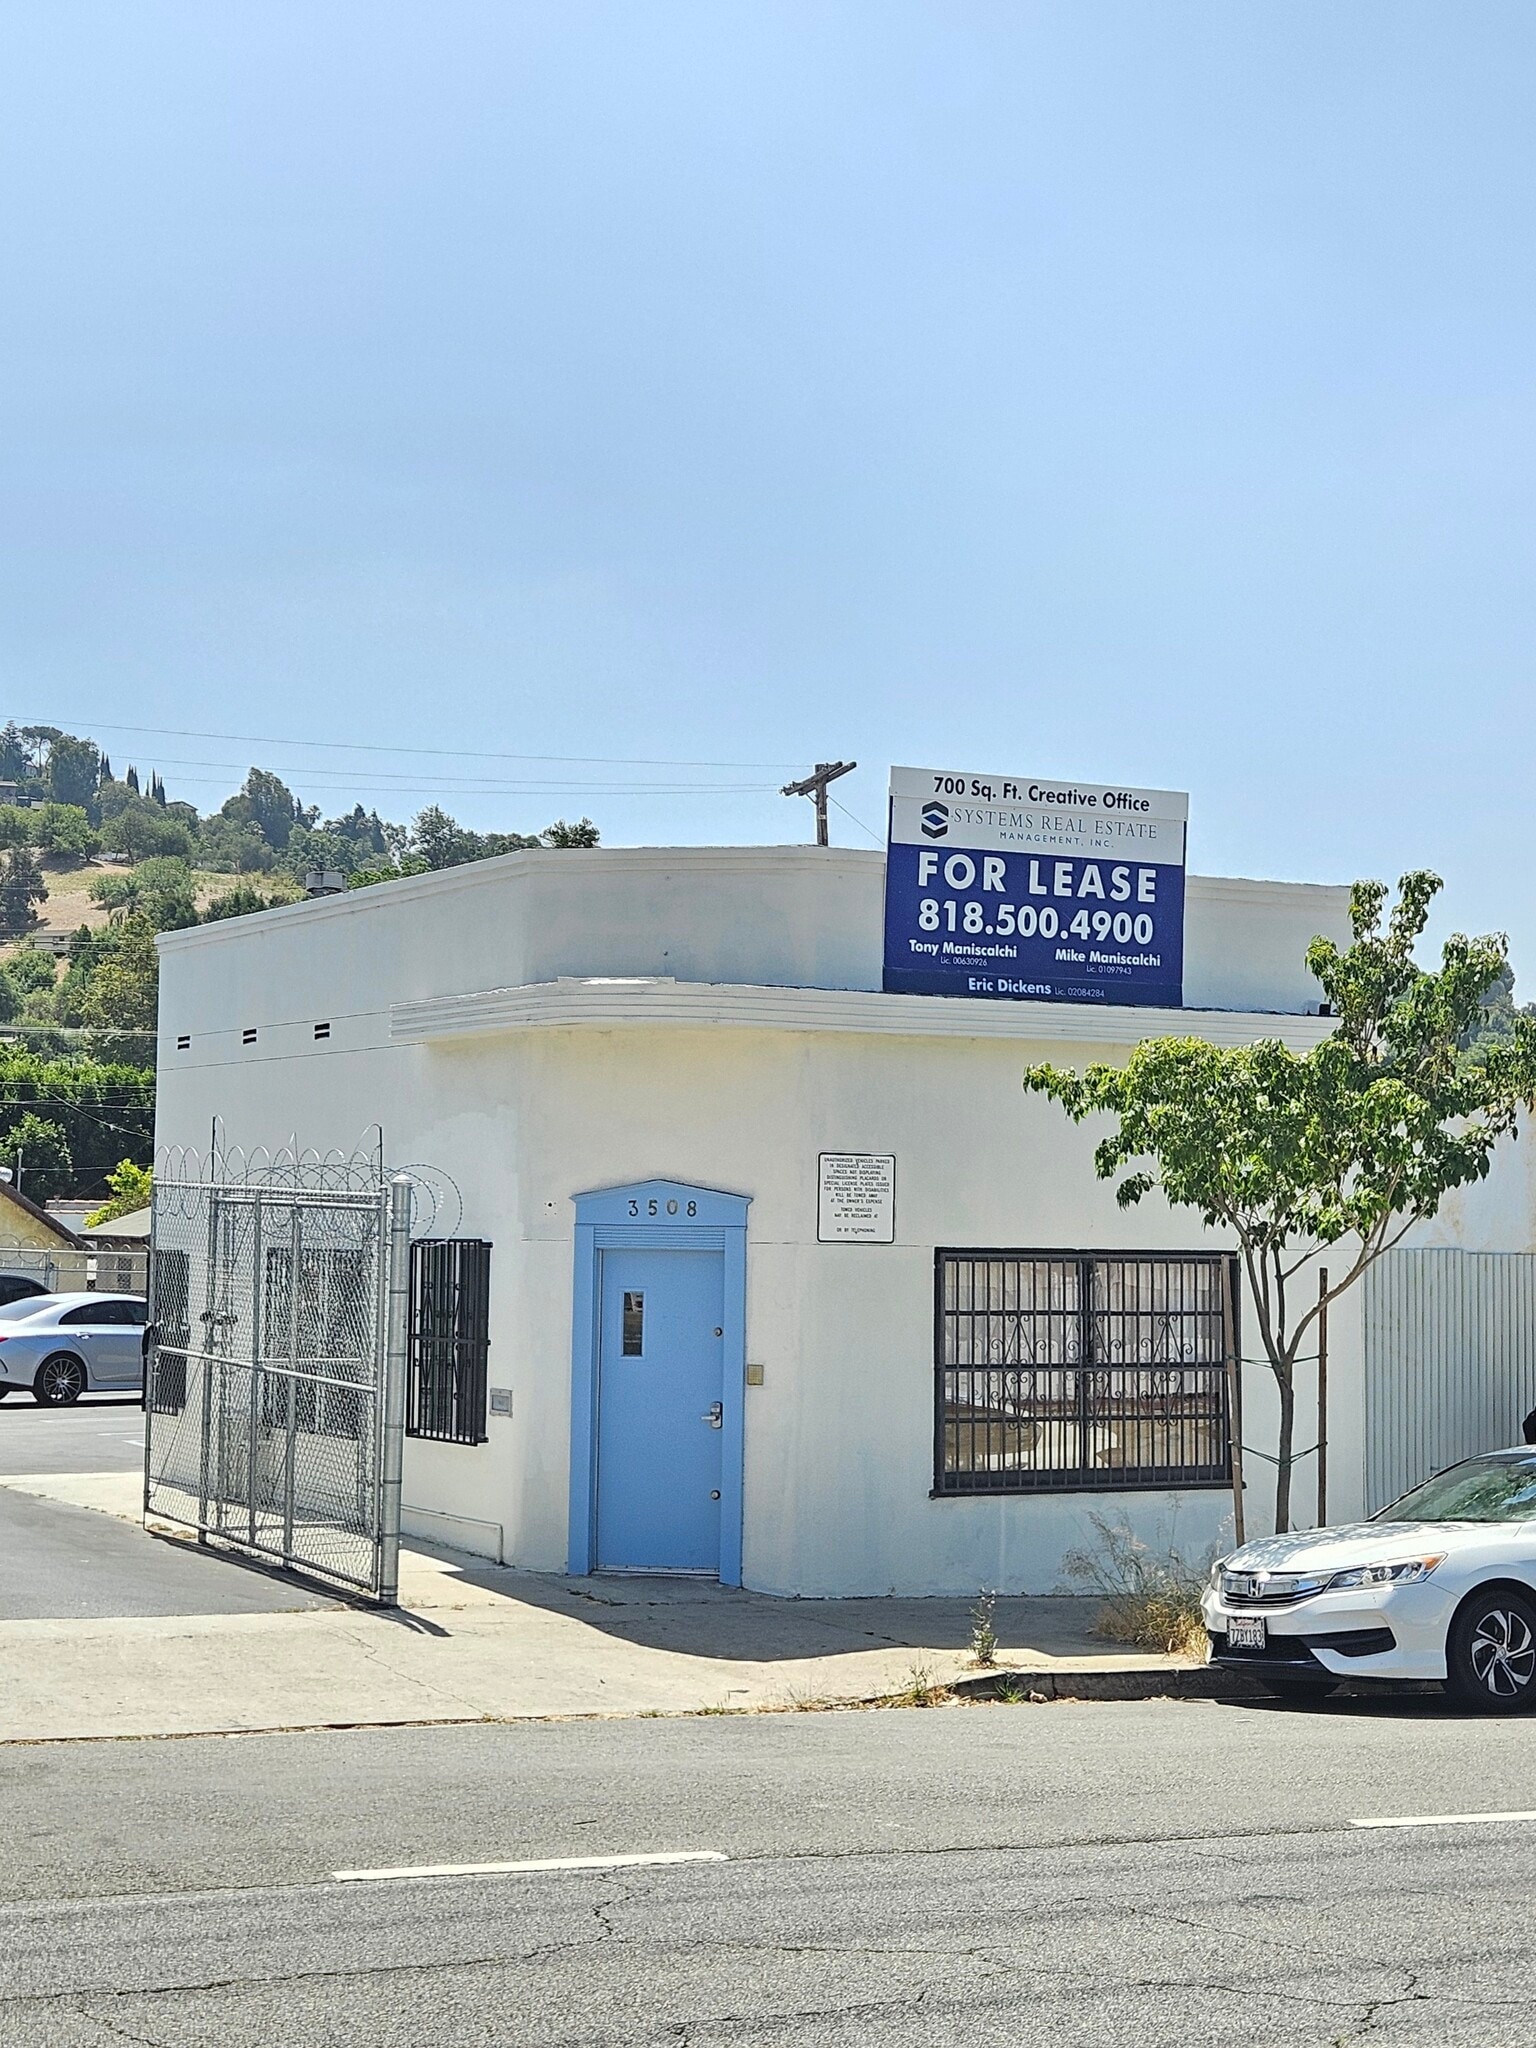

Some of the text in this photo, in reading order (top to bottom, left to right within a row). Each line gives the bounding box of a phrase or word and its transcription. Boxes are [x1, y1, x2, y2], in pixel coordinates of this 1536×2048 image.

[933, 776, 1151, 813] 700 Sq. Ft. Creative Office
[953, 808, 1158, 839] SYSTEMS REAL ESTATE
[999, 831, 1115, 848] MANAGEMENT, INC.
[918, 850, 1157, 904] FOR LEASE
[917, 897, 1154, 945] 818.500.4900
[908, 938, 1018, 959] Tony Maniscalchi
[1055, 948, 1161, 967] Mike Maniscalchi
[968, 976, 995, 993] Eric
[997, 978, 1052, 995] Dickens
[628, 1200, 697, 1217] 3508
